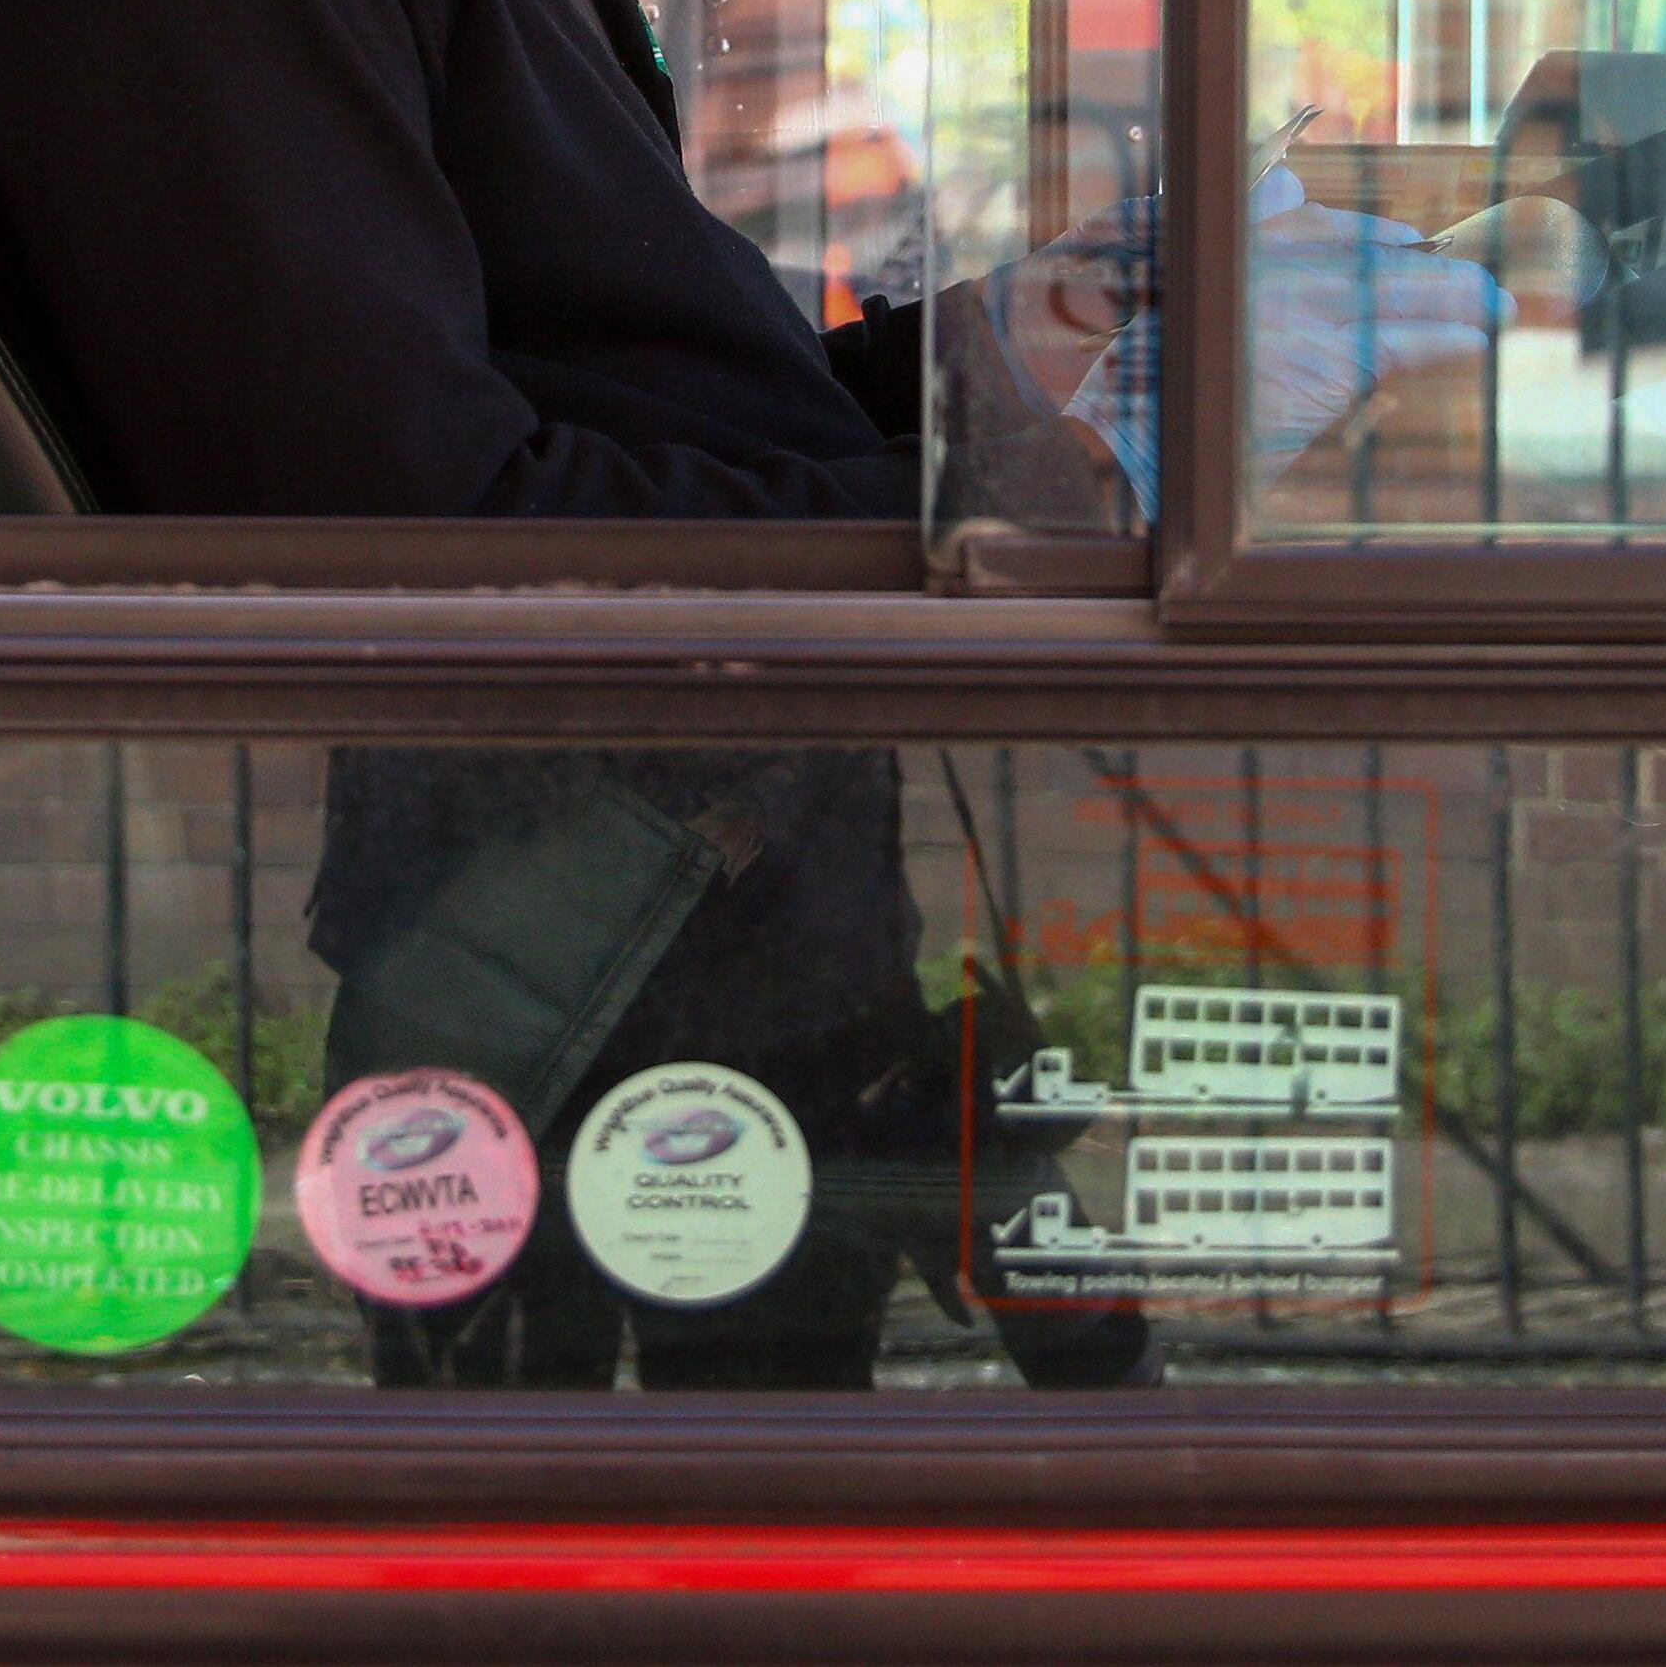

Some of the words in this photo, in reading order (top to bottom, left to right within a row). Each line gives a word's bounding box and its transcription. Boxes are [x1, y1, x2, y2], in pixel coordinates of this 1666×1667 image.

[16, 1132, 174, 1166] CHASSIS
[635, 1172, 744, 1189] QUALITY
[626, 1193, 750, 1210] CONTROL
